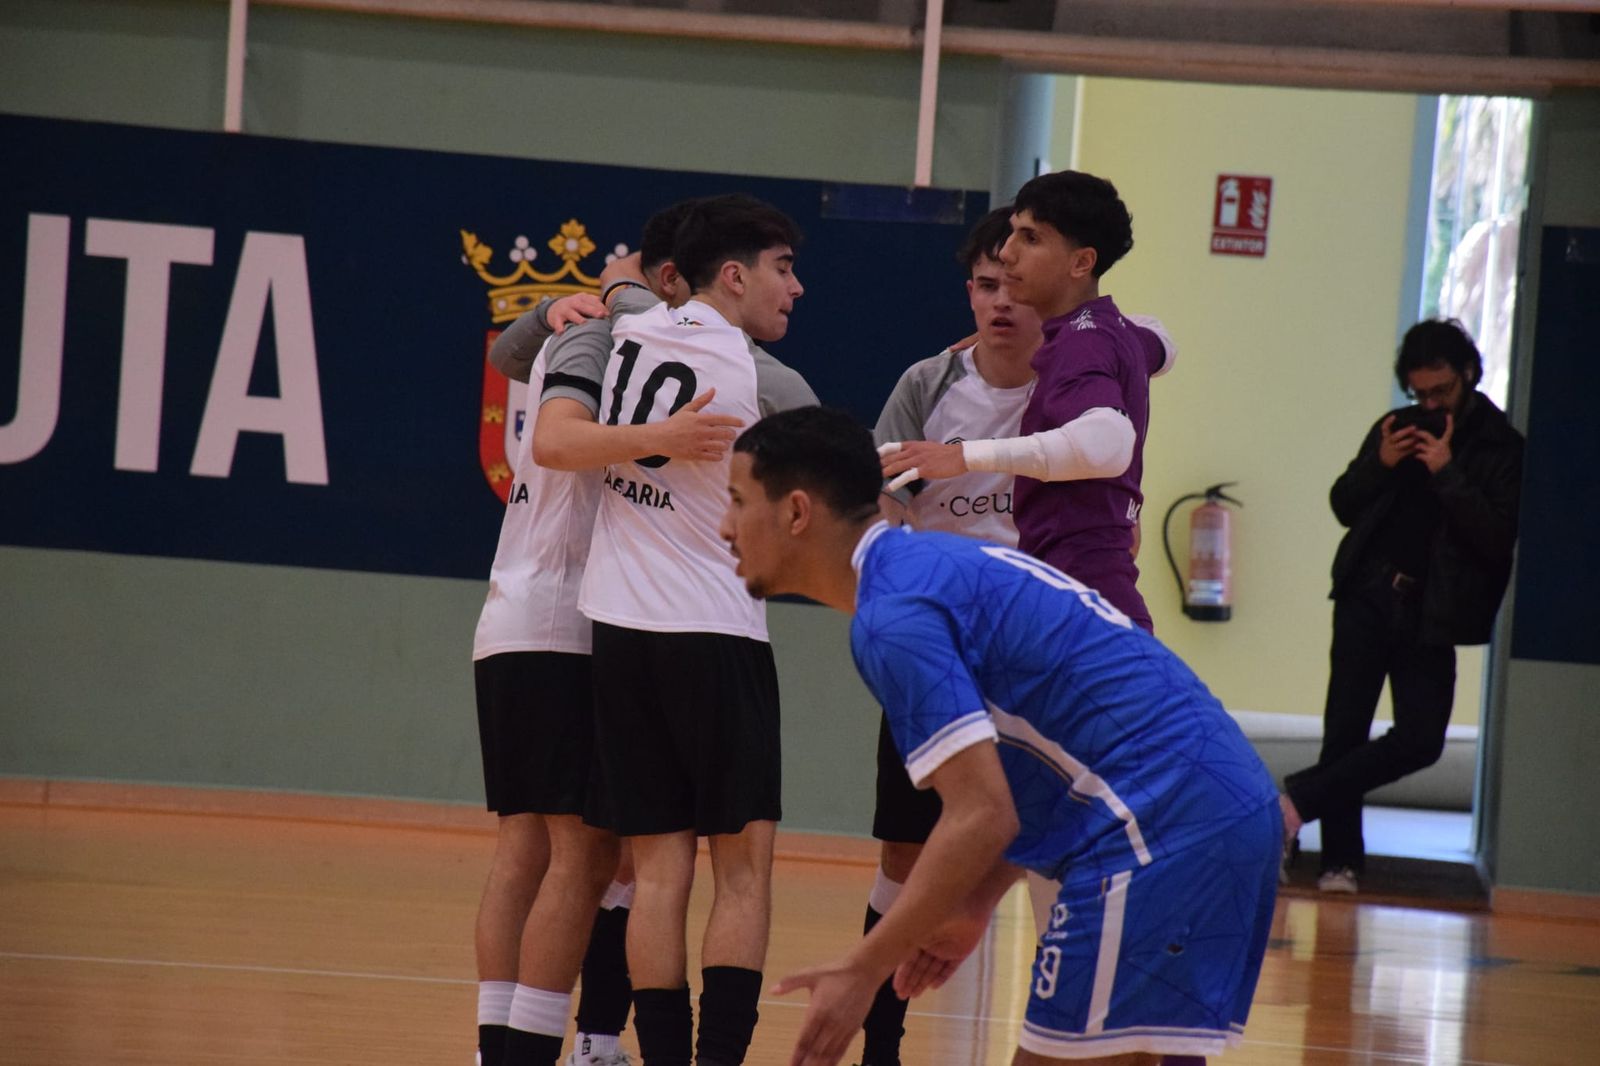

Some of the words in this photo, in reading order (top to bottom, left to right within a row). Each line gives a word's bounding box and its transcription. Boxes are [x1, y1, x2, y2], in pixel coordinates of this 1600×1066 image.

[1212, 237, 1264, 251] EXTINTOR
[607, 339, 697, 469] 10
[1036, 945, 1062, 999] 9
